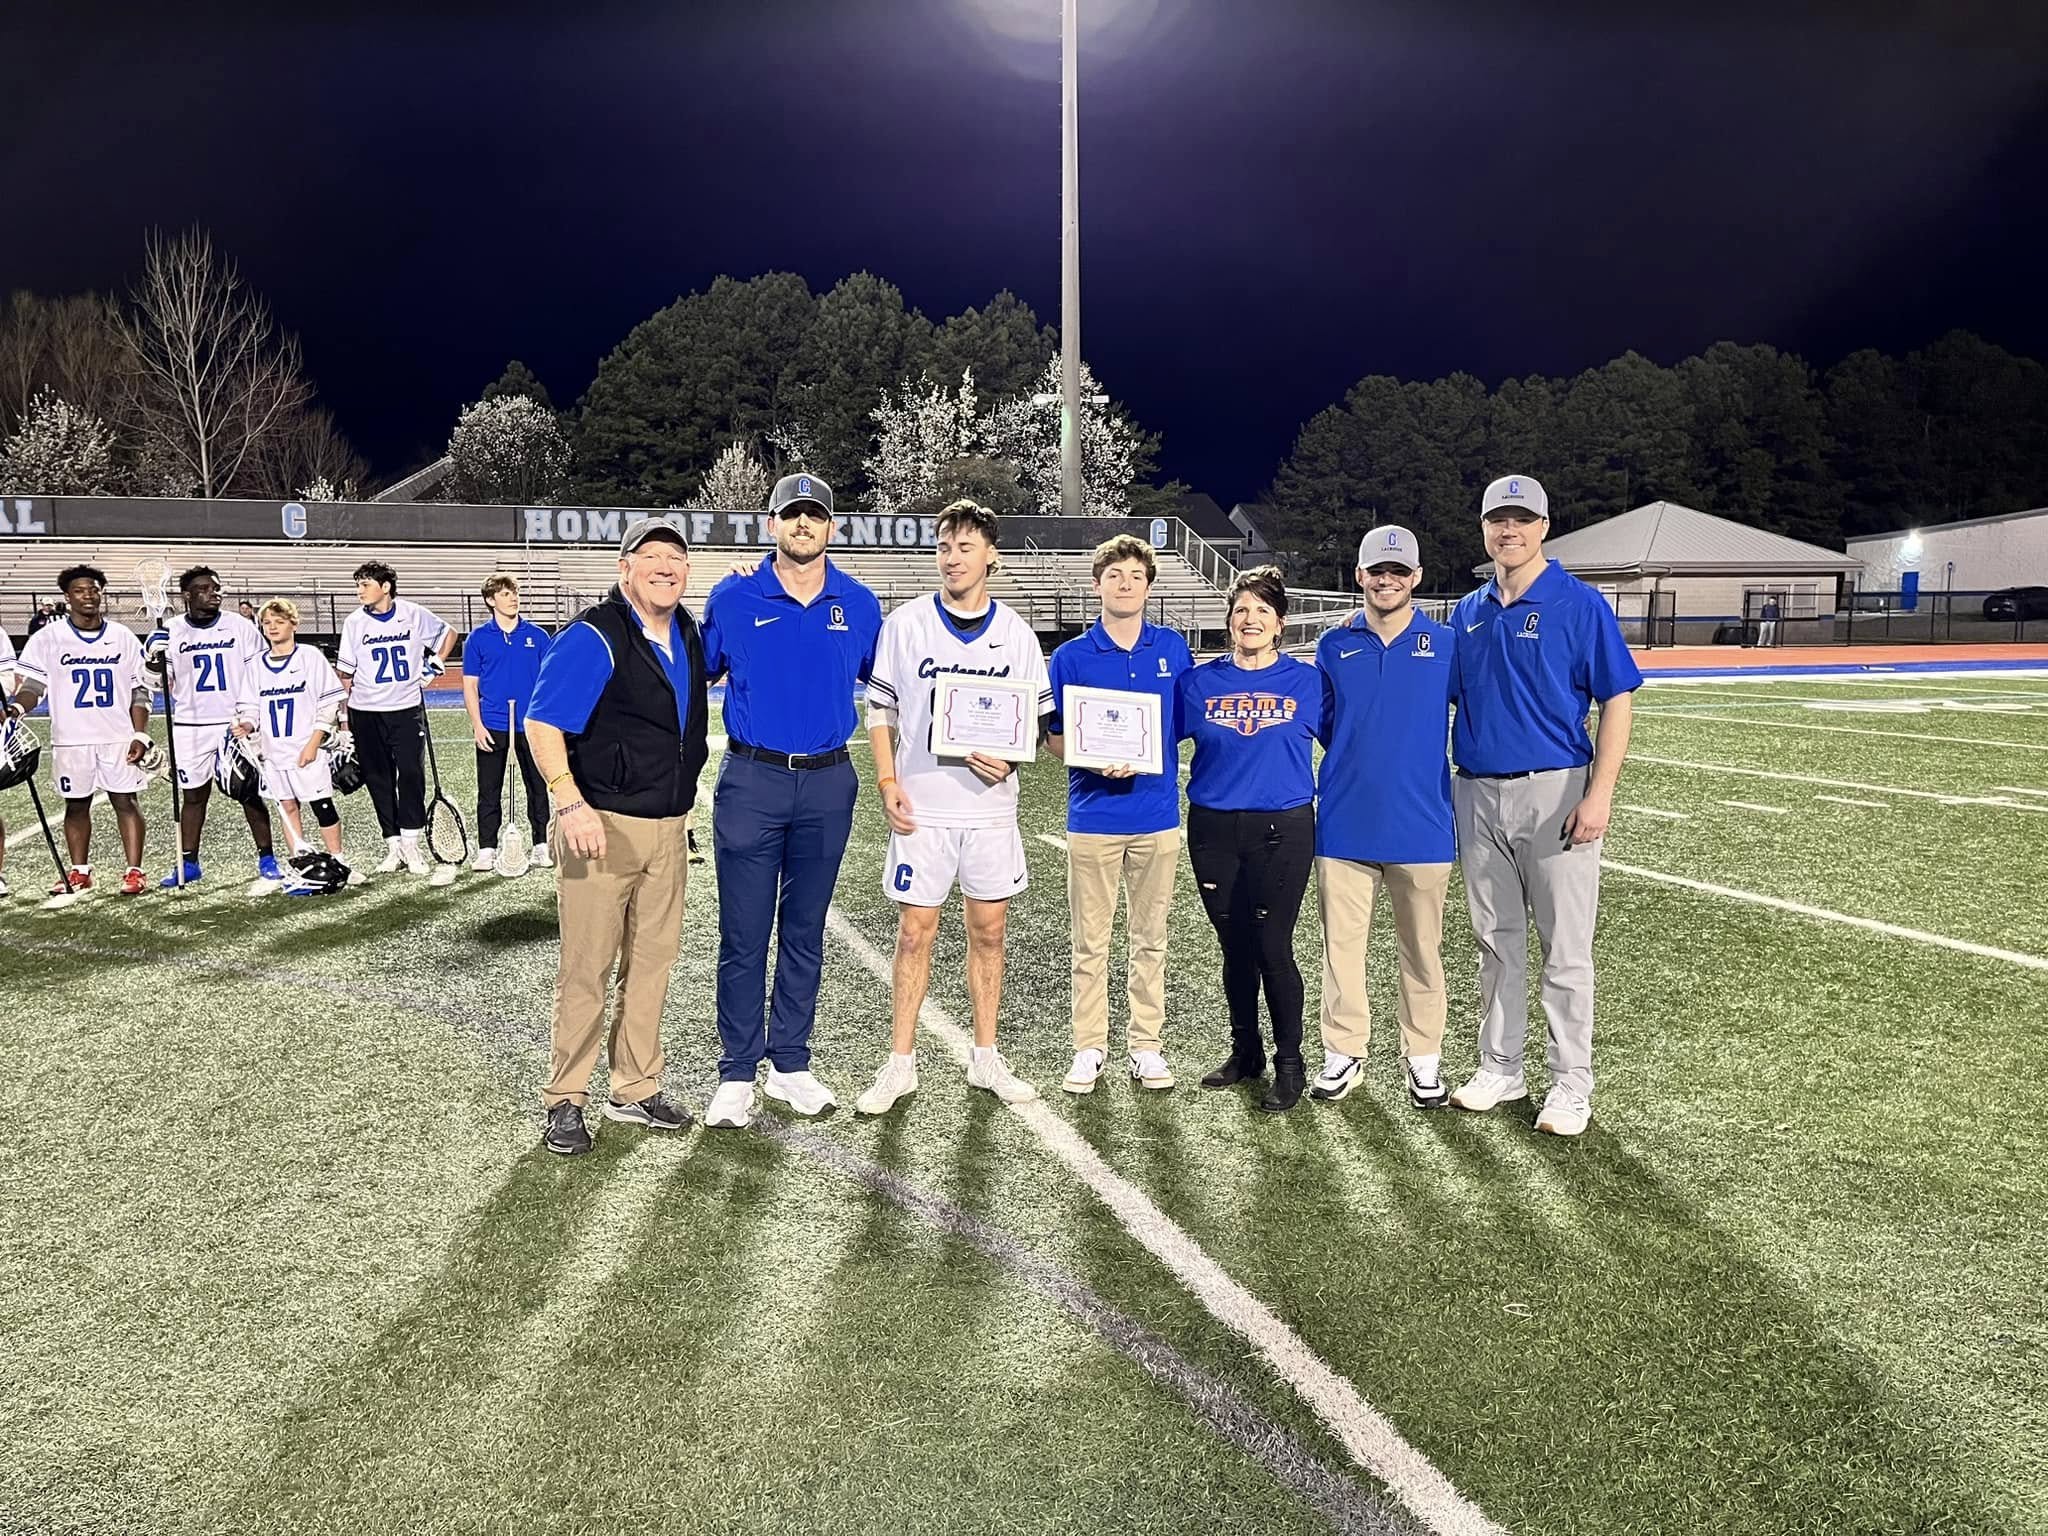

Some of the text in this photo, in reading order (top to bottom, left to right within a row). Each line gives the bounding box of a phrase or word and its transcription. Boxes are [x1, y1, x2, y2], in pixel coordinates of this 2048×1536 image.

[799, 478, 812, 493] C
[282, 502, 308, 538] C
[1150, 518, 1168, 549] C
[830, 604, 845, 625] C
[1523, 612, 1540, 633] C
[179, 638, 235, 653] Centennial
[362, 629, 411, 645] Centennial
[1417, 633, 1431, 652] C
[60, 653, 122, 666] Centennial
[371, 645, 410, 684] 26
[193, 653, 227, 692] 21
[71, 668, 114, 709] 29
[259, 680, 307, 697] entennial
[1205, 698, 1277, 711] TEAM
[1205, 710, 1294, 719] LACROSSE
[269, 698, 294, 738] 17
[60, 776, 71, 792] C
[894, 863, 914, 892] C
